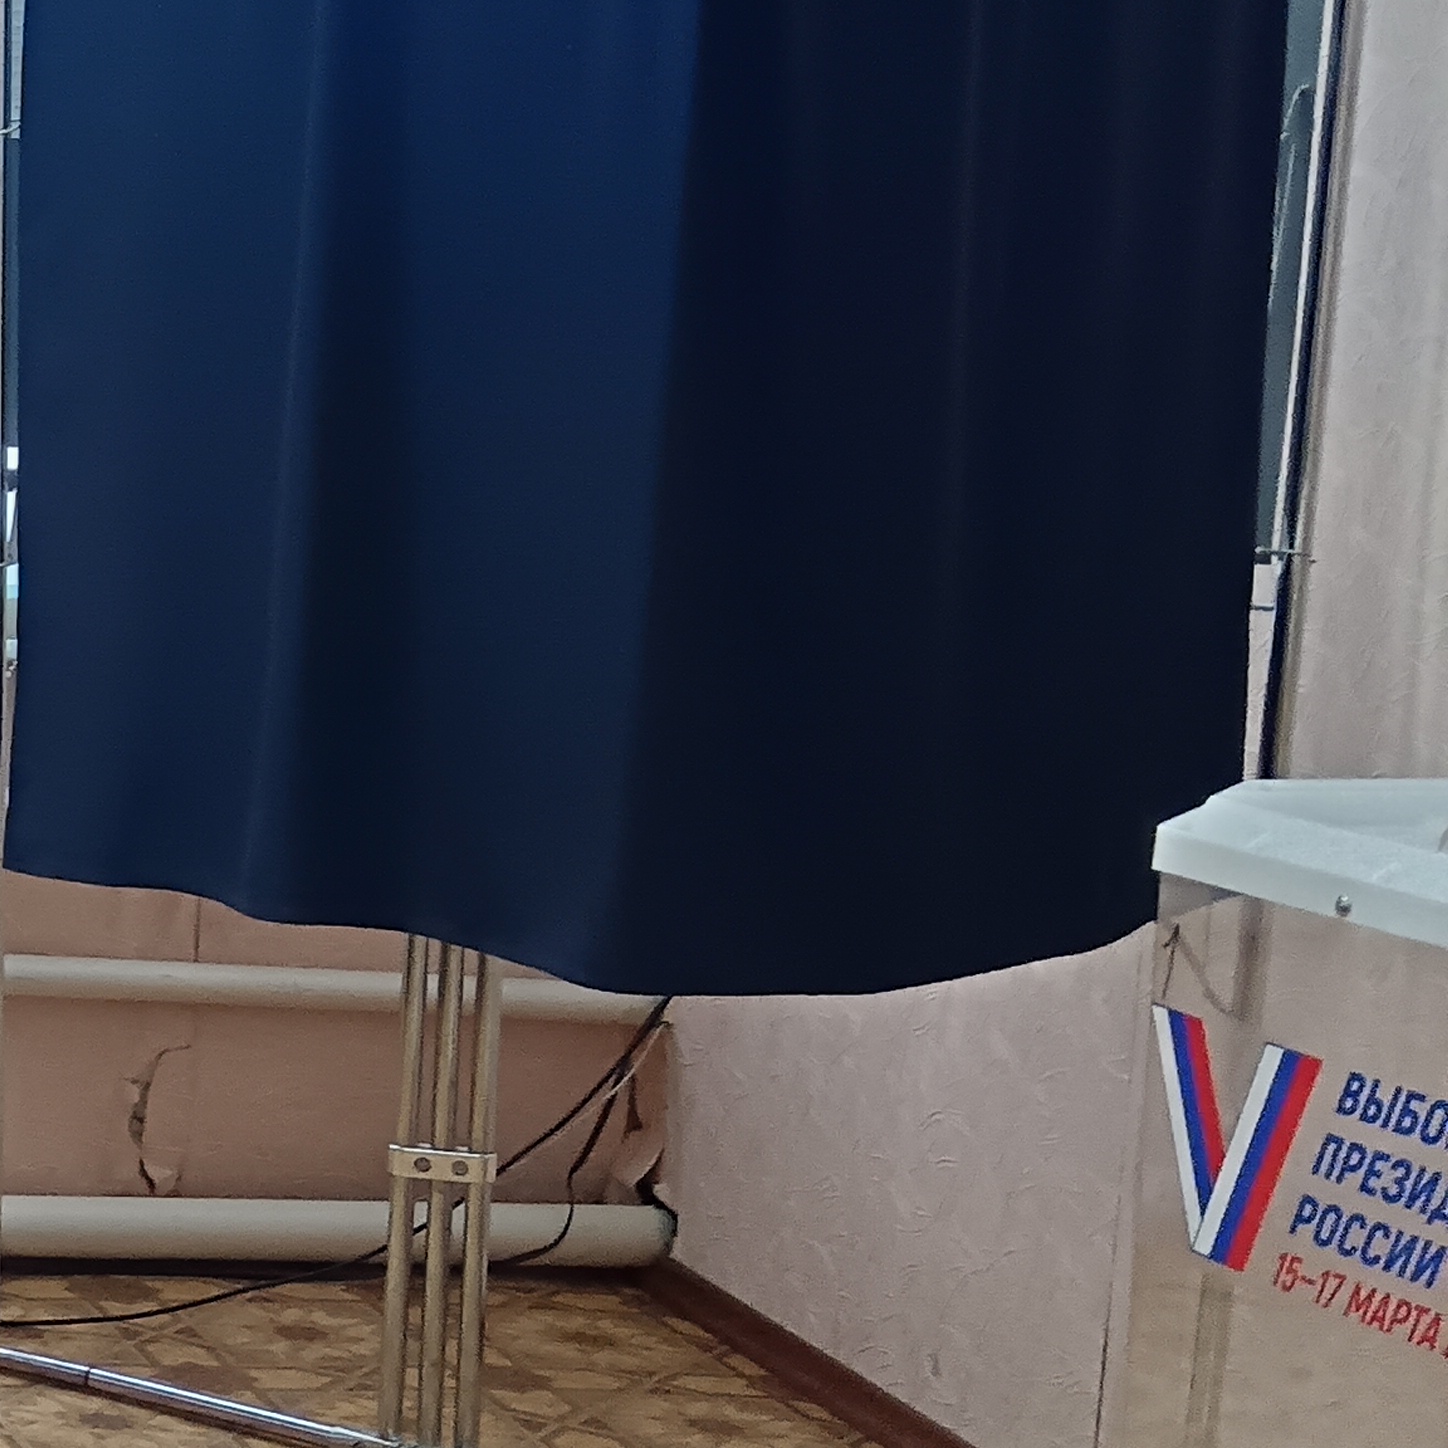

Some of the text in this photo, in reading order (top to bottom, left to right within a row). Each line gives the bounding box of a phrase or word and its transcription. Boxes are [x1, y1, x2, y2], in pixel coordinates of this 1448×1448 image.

[1334, 1070, 1448, 1148] ВЫБО
[1288, 1192, 1447, 1290] РОССИИ
[1342, 1281, 1443, 1351] МАРТА
